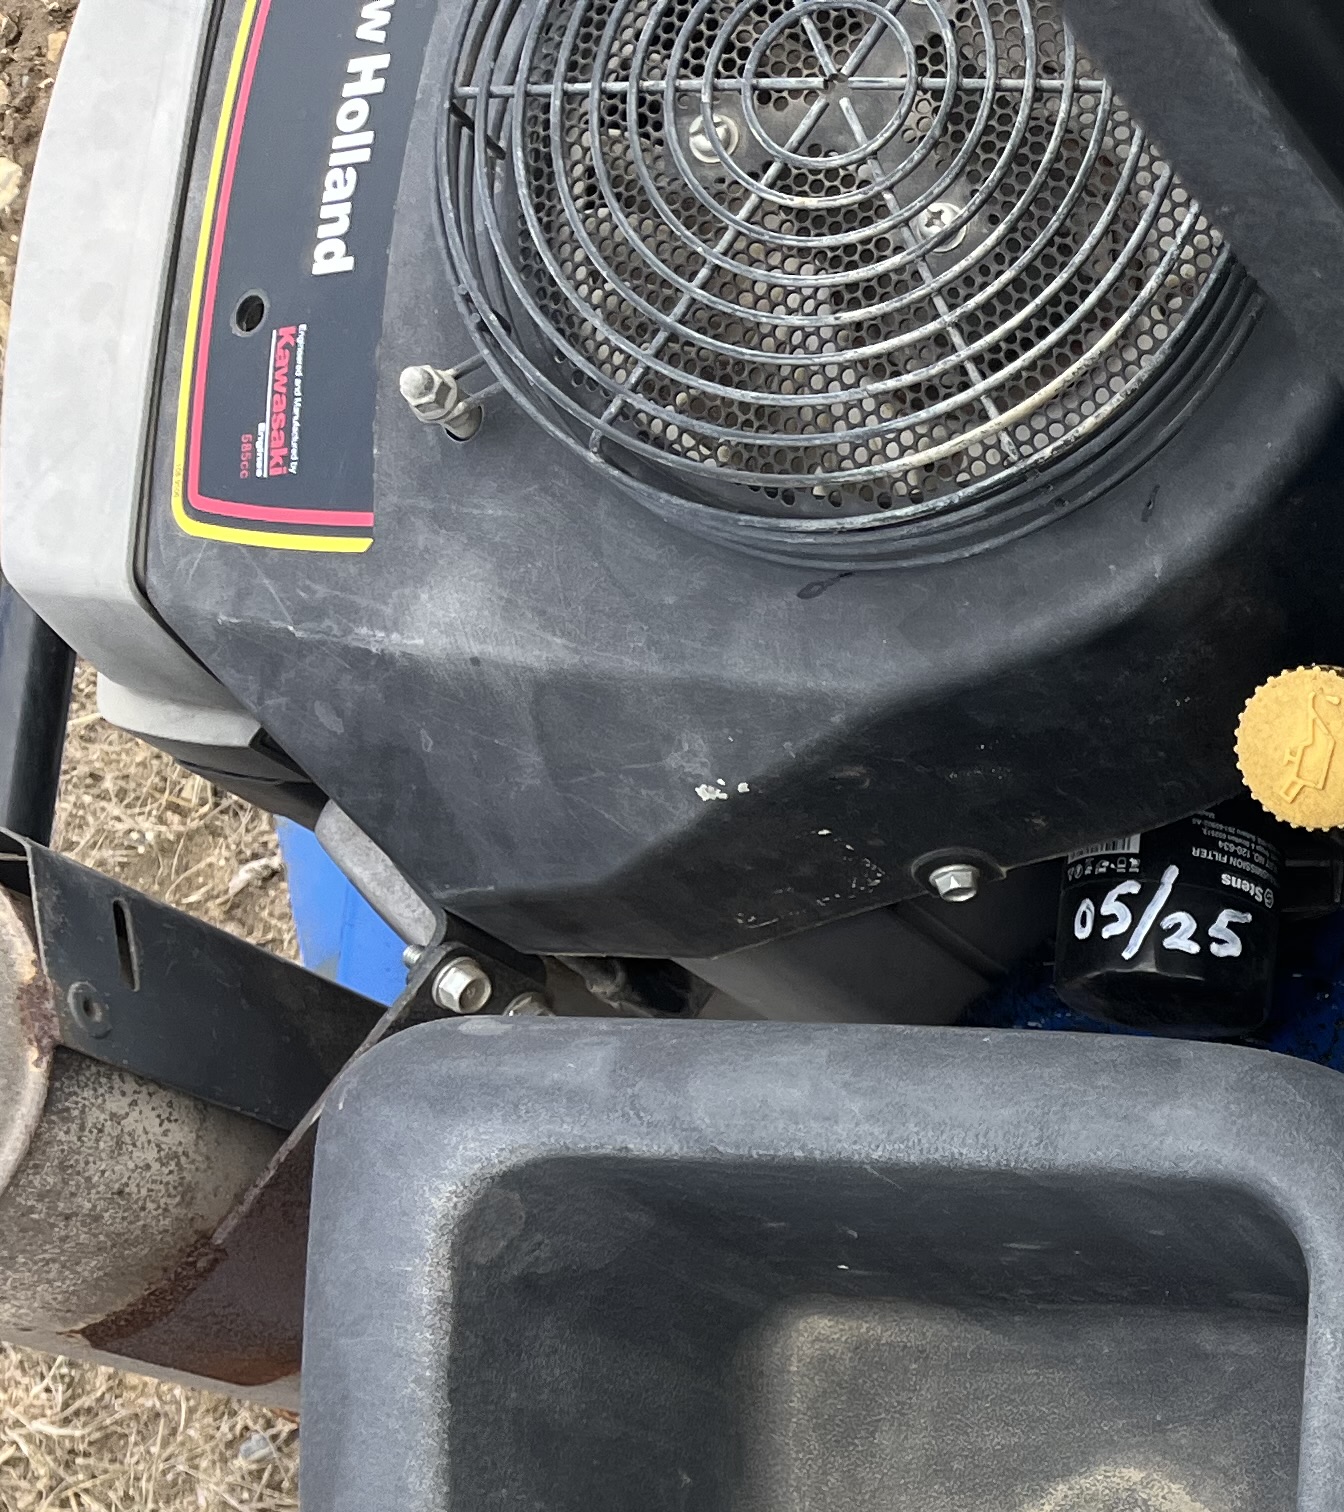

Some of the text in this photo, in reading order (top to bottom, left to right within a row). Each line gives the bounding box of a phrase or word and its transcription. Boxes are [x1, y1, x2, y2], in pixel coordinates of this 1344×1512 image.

[311, 53, 392, 276] Holland
[295, 323, 308, 377] Engineered
[269, 325, 298, 477] Kawasaki
[294, 377, 303, 397] and
[255, 422, 266, 478] Engines
[290, 397, 302, 461] Manufactured
[1191, 846, 1228, 864] FILTER
[1218, 840, 1252, 859] 120-634
[1073, 864, 1253, 960] 05/25
[1220, 873, 1264, 903] Stens
